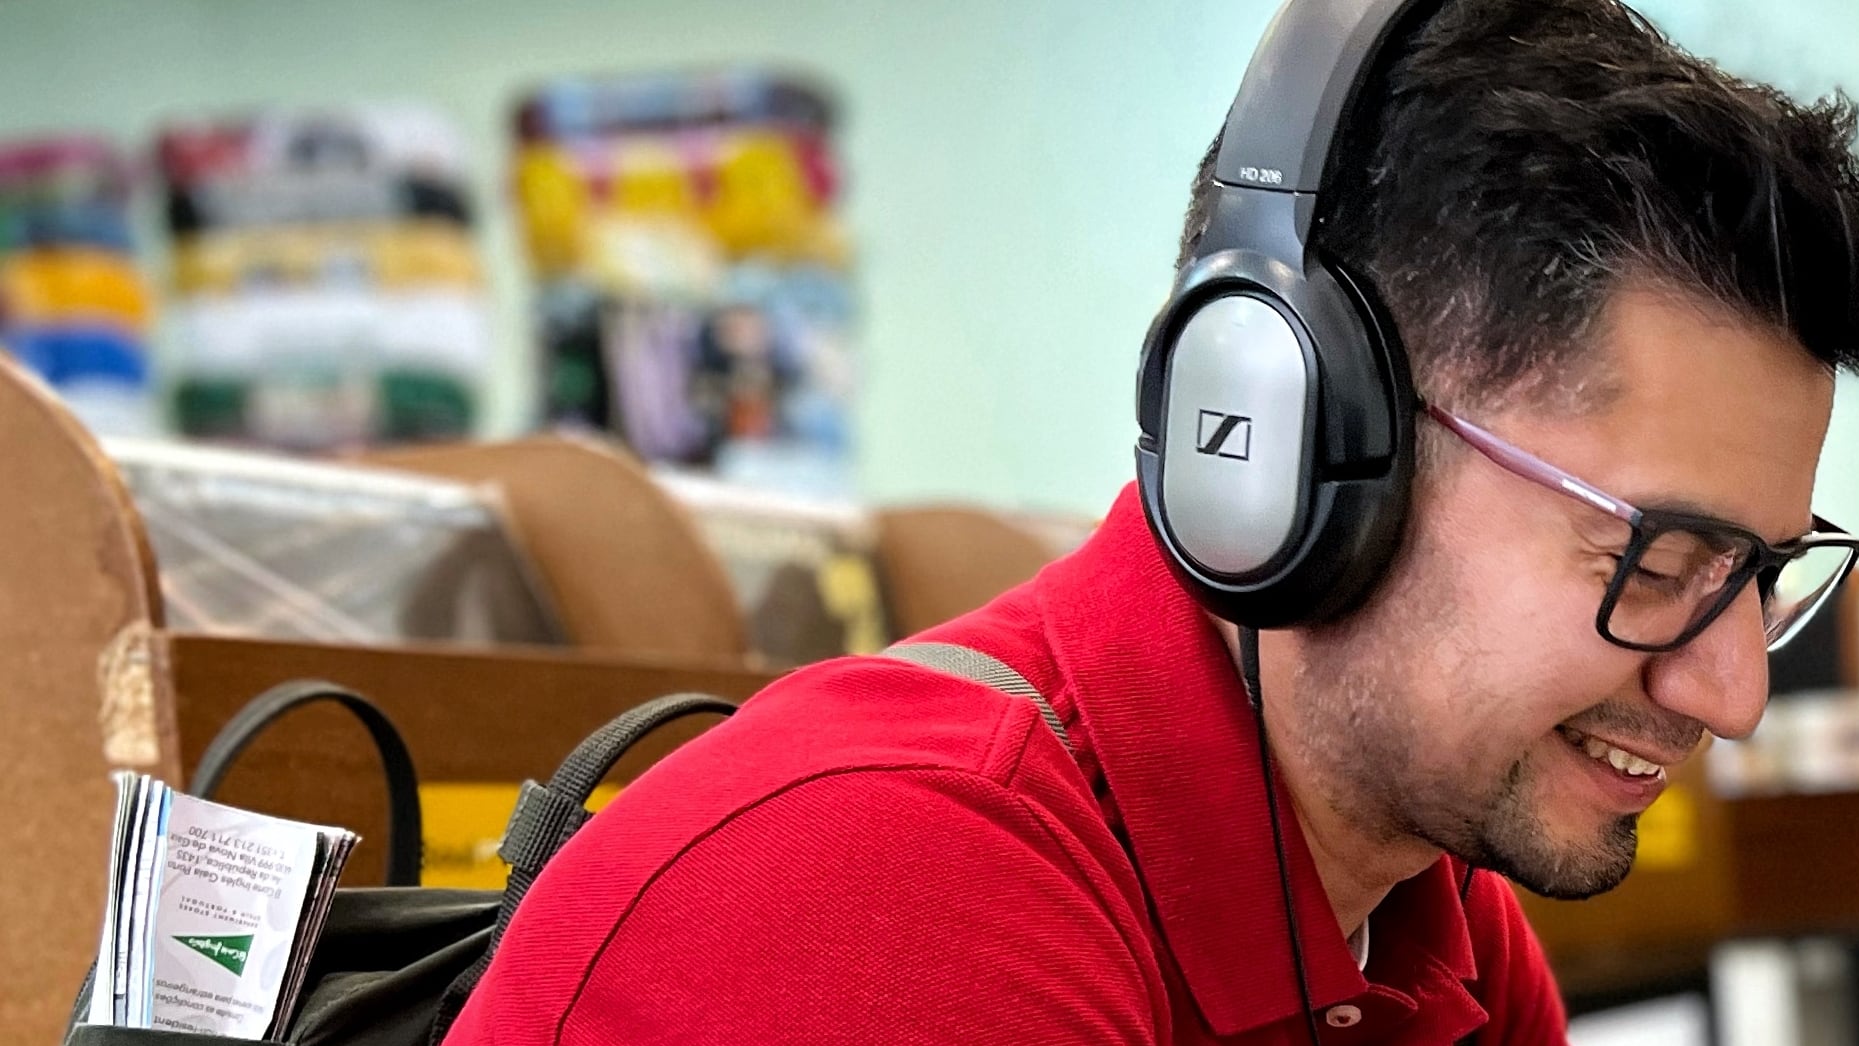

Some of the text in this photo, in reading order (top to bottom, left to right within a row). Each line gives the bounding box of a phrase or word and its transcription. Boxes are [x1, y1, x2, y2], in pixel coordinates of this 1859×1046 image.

[1240, 166, 1258, 181] HD
[188, 826, 207, 839] 700
[211, 832, 231, 846] 711
[192, 839, 206, 850] de
[233, 838, 254, 852] 213
[175, 849, 200, 864] 1435
[208, 845, 236, 860] Nova
[239, 853, 256, 867] Vila
[166, 860, 191, 875] Porto
[193, 867, 218, 883] Gaia
[220, 875, 250, 892] Inglés
[178, 902, 210, 916] STORES
[154, 993, 203, 1012] condições
